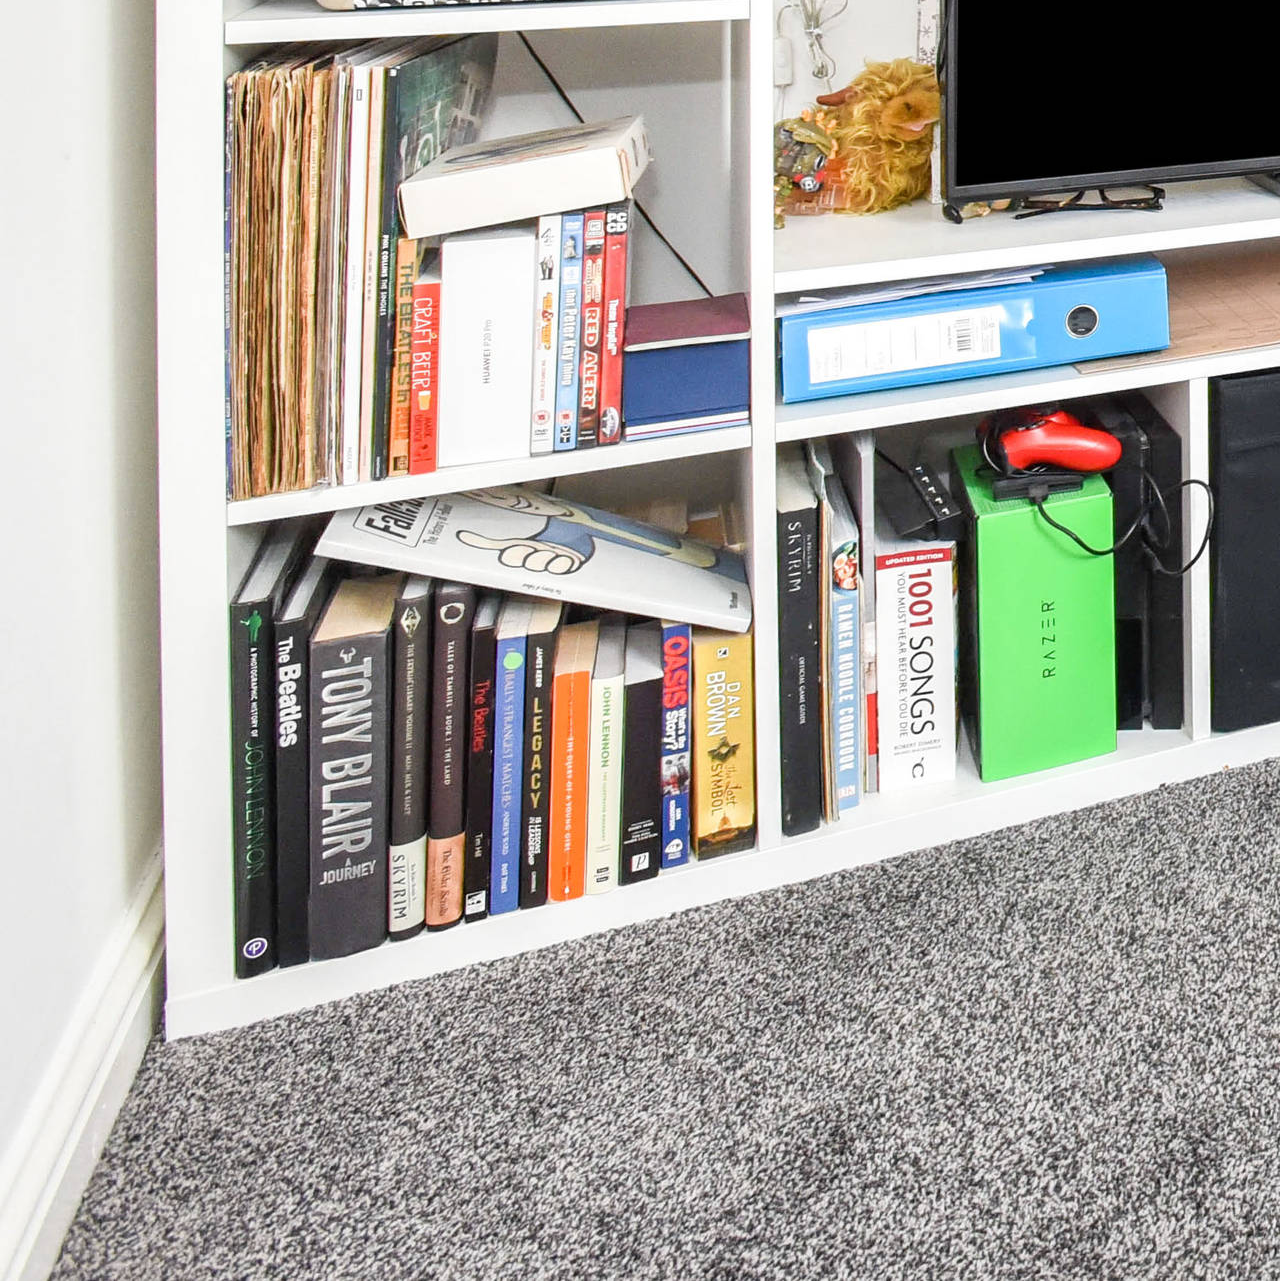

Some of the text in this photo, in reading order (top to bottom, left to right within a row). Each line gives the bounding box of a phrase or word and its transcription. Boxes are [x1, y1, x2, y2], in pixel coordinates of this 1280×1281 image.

[606, 222, 627, 233] CD
[607, 212, 627, 223] PC
[380, 251, 389, 277] COLLINS
[379, 291, 387, 316] SINGLES
[397, 262, 414, 385] THE BEATLES
[585, 307, 600, 346] RED
[412, 298, 434, 390] CRAFT BEER
[483, 349, 492, 384] HUAWEI
[561, 289, 578, 385] that Peter Kay thing
[582, 350, 599, 410] ALERT
[787, 521, 801, 593] SKYRIM
[885, 552, 944, 566] UPDATED EDITION
[447, 640, 455, 662] TALES
[897, 572, 908, 737] YOU MUST HEAR BEFORE YOU DIE
[908, 568, 935, 736] 1001 SONGS
[1041, 599, 1056, 679] RAZER
[278, 636, 302, 748] The Beatles
[663, 635, 689, 709] OASIS
[726, 681, 742, 719] DAN
[838, 604, 855, 770] RAMEN NOODLE COOKBOOK
[472, 679, 491, 754] The Beatles
[601, 686, 611, 768] JOHN LENNON
[663, 710, 679, 751] Story?
[677, 707, 688, 735] What's
[706, 670, 727, 737] BROWN
[245, 653, 265, 880] PHOTOGRAPHIC HISTORY OF JOHN LENNON
[322, 657, 373, 860] TONY BLAIR
[444, 765, 452, 785] LAND
[501, 704, 514, 808] STRANGEST MATCHES
[530, 697, 543, 809] LEGACY
[565, 755, 574, 779] DIARY
[565, 802, 573, 830] YOUNG
[710, 763, 723, 816] SYMBOL
[724, 780, 742, 807] Lost
[534, 825, 542, 854] LESSONS
[319, 860, 376, 885] JOURNEY
[392, 854, 407, 919] SKYRIM
